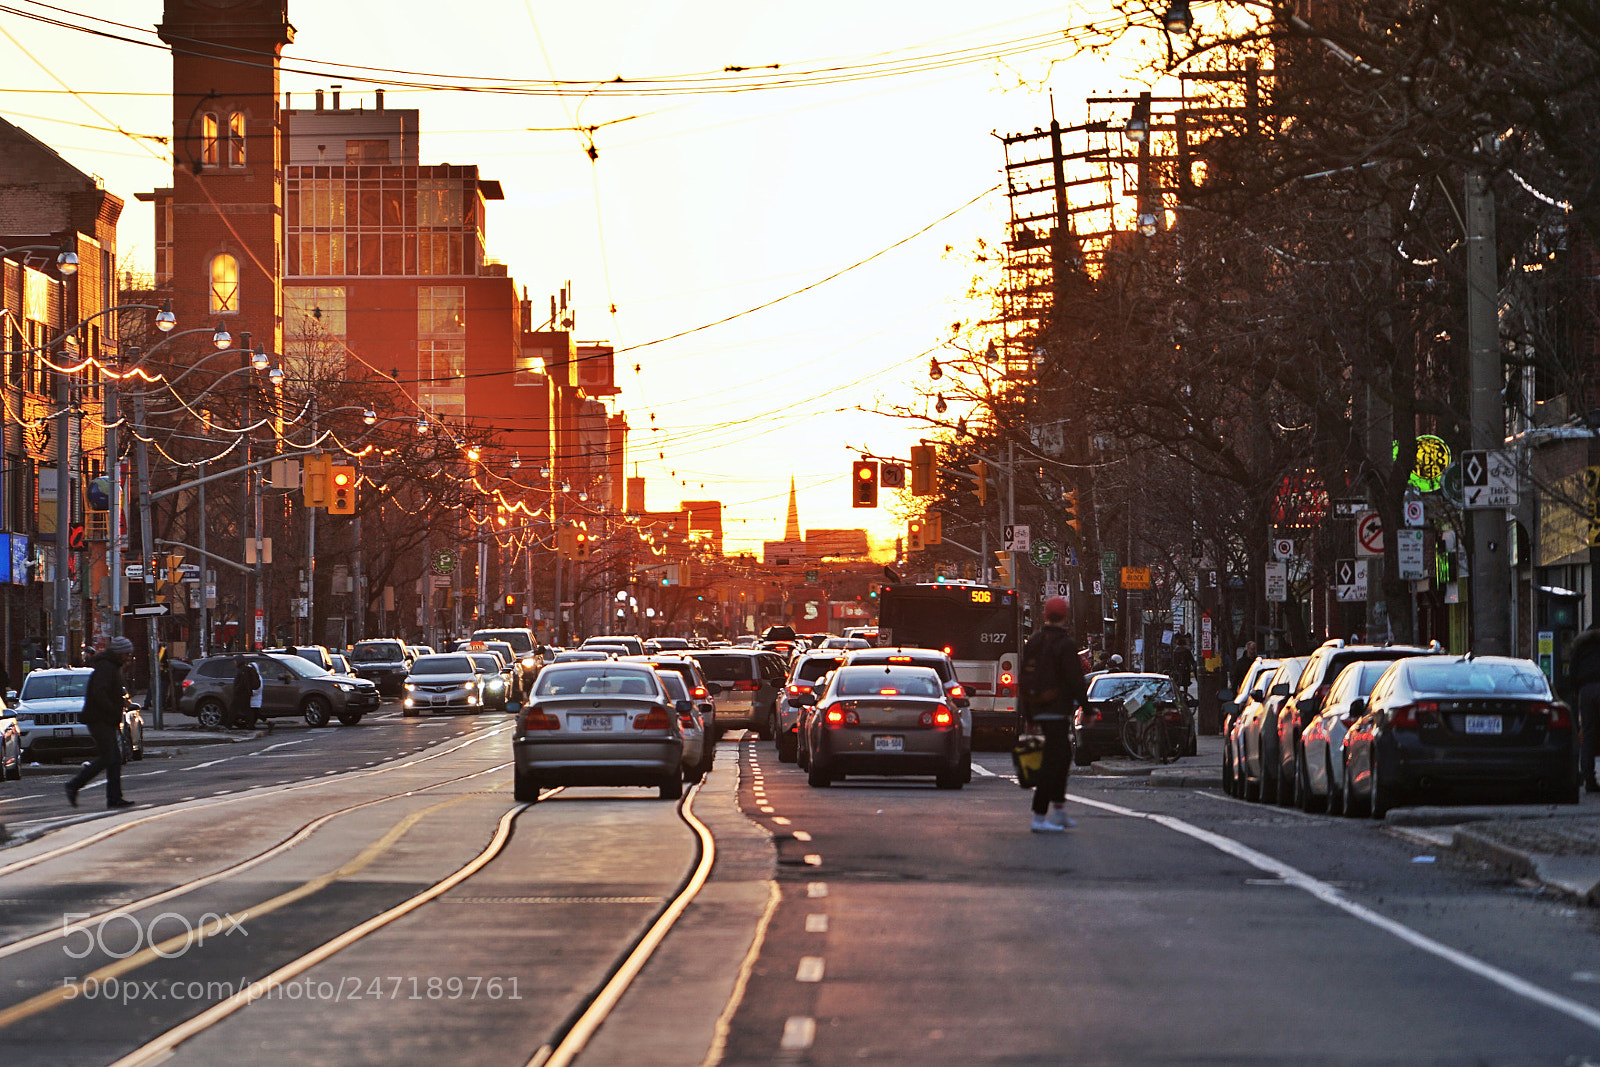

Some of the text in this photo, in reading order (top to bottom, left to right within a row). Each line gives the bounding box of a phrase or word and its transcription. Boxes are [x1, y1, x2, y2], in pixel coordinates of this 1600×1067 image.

[1490, 487, 1509, 495] THIS
[1488, 496, 1511, 504] LANE
[971, 590, 992, 603] 506
[980, 633, 1007, 643] 8127
